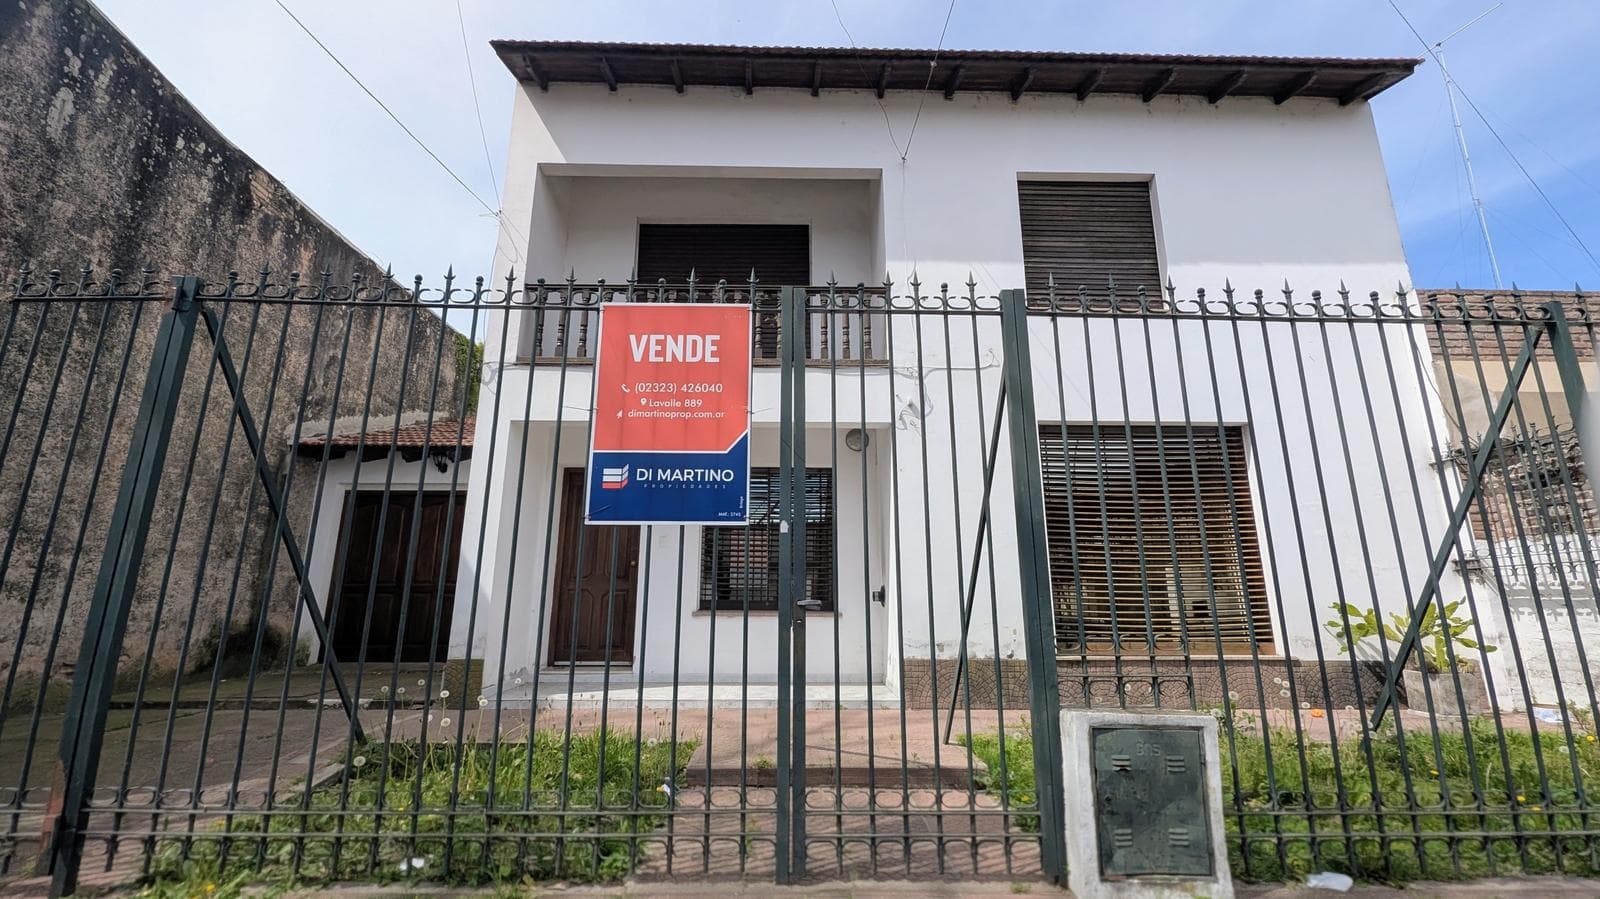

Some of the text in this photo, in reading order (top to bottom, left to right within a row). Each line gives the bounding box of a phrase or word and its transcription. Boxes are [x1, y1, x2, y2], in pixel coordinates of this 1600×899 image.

[629, 334, 721, 363] VENDE
[635, 382, 723, 394] (02323) 426040
[649, 399, 703, 408] Lavalle 889
[628, 409, 725, 419] dimartinoprop.com.ar
[636, 468, 734, 482] DI MARTINO
